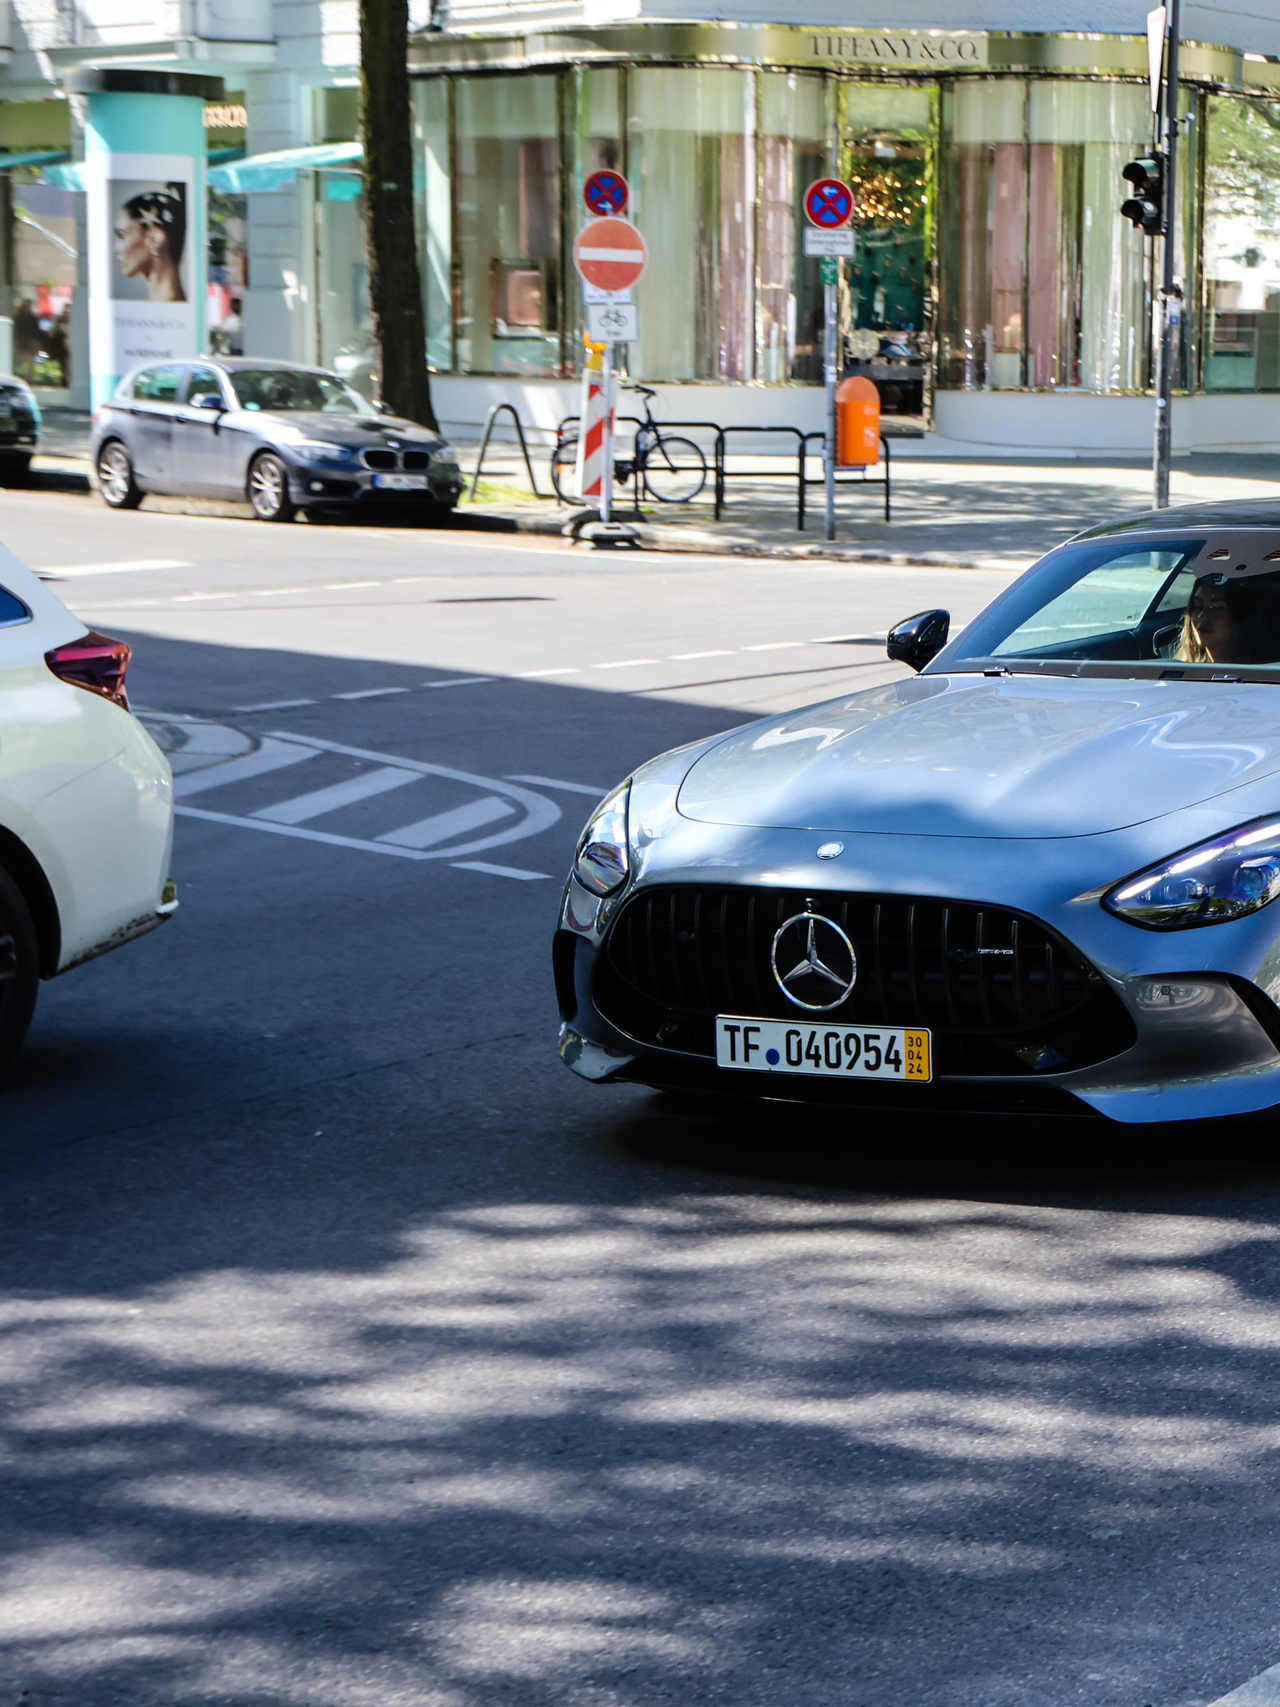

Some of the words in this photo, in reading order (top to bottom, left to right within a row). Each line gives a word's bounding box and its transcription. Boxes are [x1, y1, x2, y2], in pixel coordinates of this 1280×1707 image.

[907, 1036, 923, 1048] 30
[723, 1024, 761, 1063] TF
[785, 1029, 903, 1073] 040954
[907, 1049, 923, 1061] 04
[907, 1062, 923, 1075] 24
